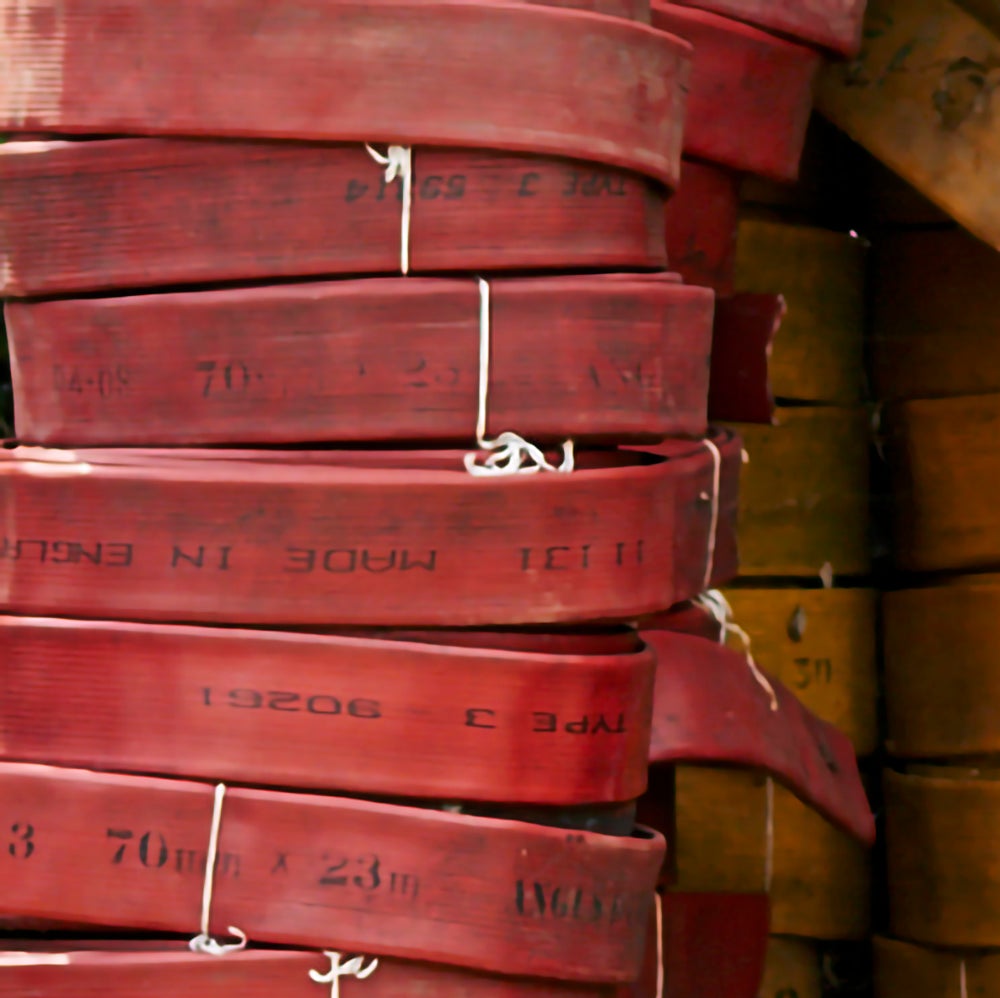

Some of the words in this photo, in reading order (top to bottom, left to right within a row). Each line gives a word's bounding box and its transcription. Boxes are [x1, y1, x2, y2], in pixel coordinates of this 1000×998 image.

[169, 543, 234, 571] IN
[284, 545, 439, 575] MADE
[199, 685, 383, 721] 90261
[463, 707, 497, 731] 3
[532, 710, 629, 737] TYPE
[6, 820, 37, 861] 3
